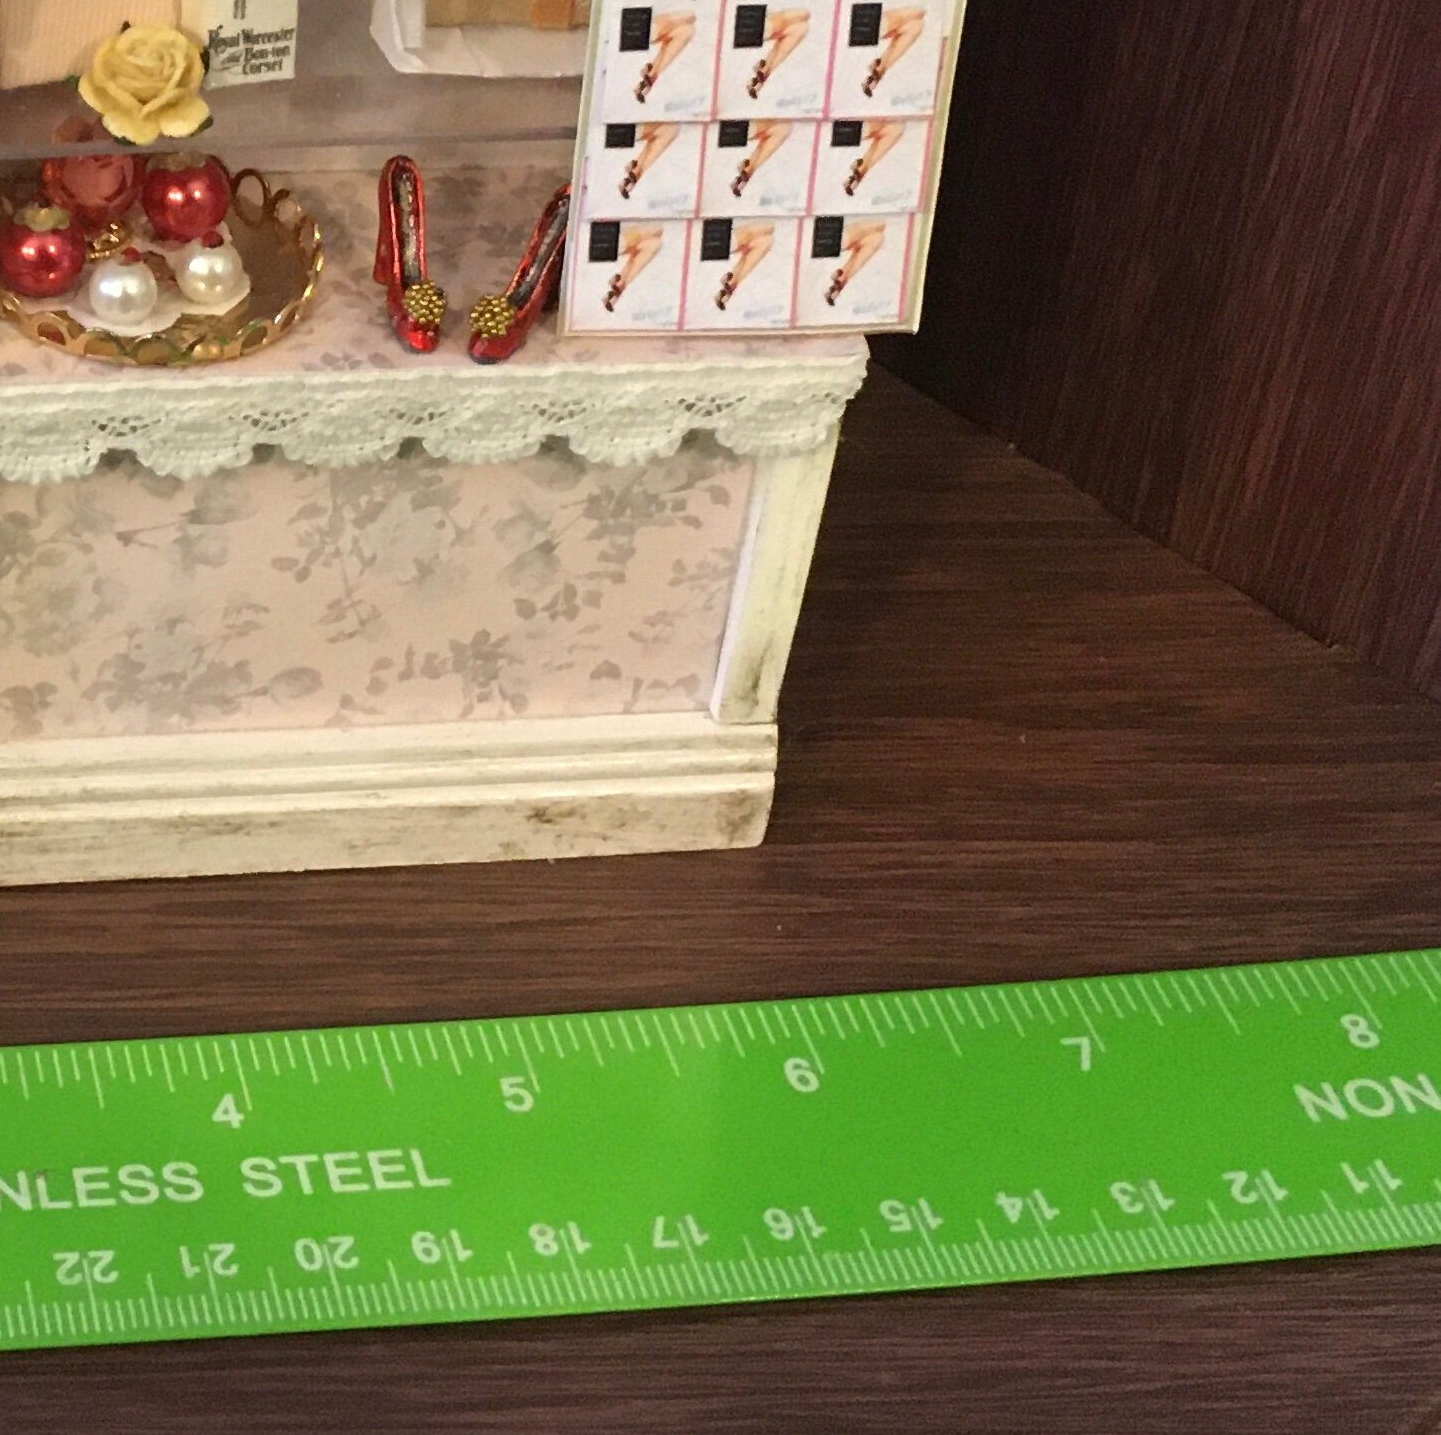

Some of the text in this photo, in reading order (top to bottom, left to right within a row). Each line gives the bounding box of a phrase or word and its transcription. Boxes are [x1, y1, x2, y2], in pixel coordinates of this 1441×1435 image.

[212, 1094, 245, 1128] 4
[500, 1076, 534, 1112] 5
[783, 1057, 820, 1093] 6
[1059, 1036, 1092, 1072] 7
[1340, 1013, 1380, 1048] 8
[1293, 1073, 1440, 1122] NON
[240, 1147, 451, 1199] STEEL
[1221, 1169, 1289, 1204] 12
[1341, 1158, 1403, 1194] 11
[995, 1189, 1060, 1224] 14
[1109, 1179, 1175, 1214] 13
[652, 1214, 709, 1248] 17
[763, 1206, 827, 1241] 16
[878, 1197, 944, 1233] 15
[294, 1236, 359, 1271] 20
[411, 1228, 473, 1264] 19
[527, 1221, 592, 1256] 18
[53, 1250, 119, 1286] 22
[179, 1243, 239, 1279] 21
